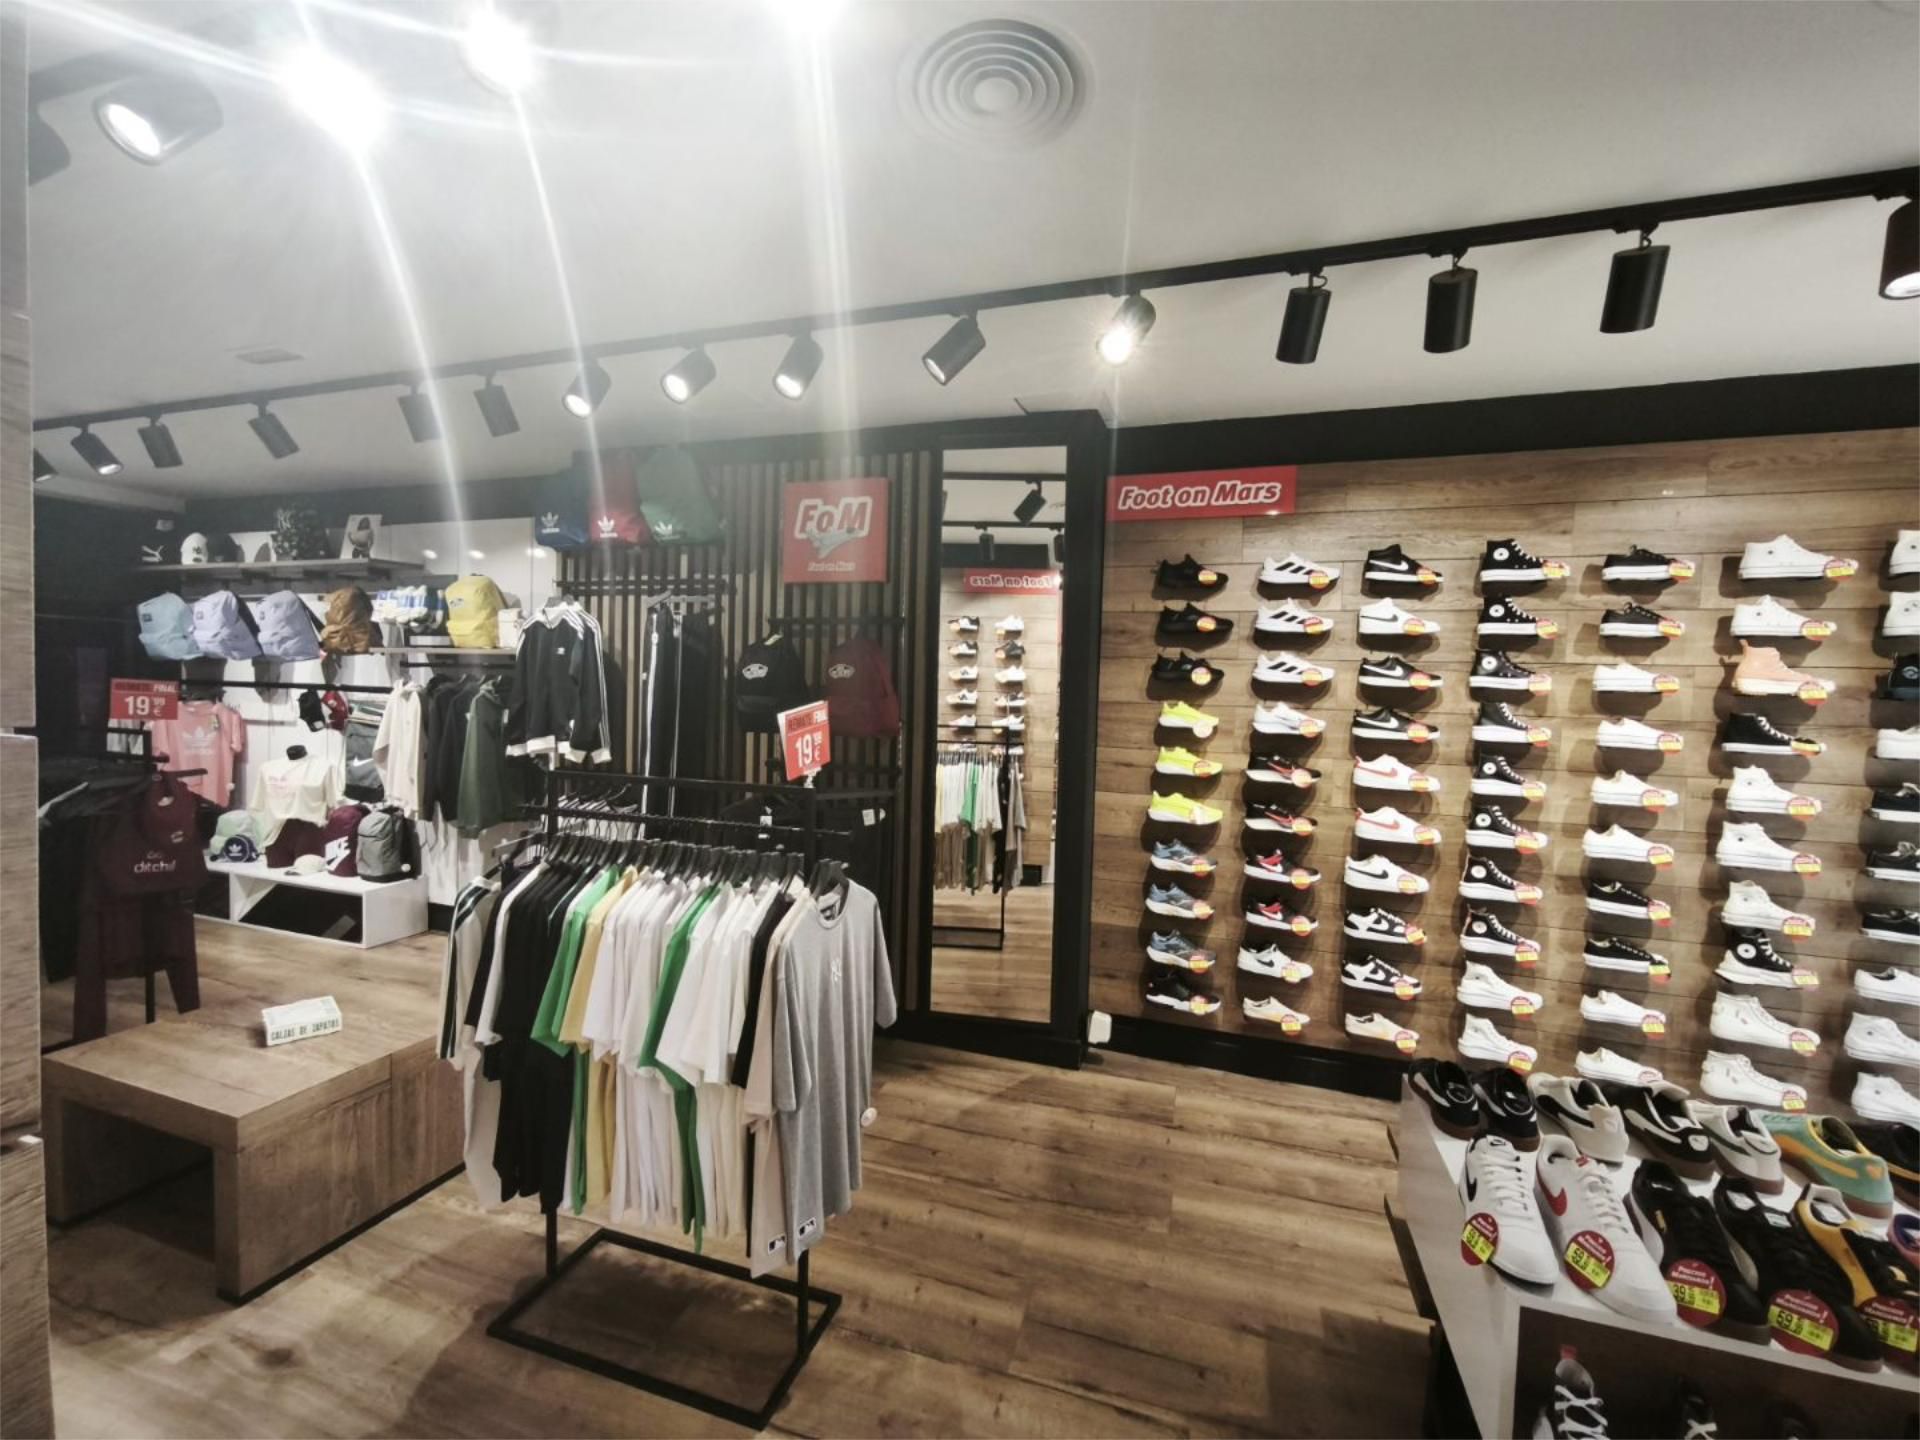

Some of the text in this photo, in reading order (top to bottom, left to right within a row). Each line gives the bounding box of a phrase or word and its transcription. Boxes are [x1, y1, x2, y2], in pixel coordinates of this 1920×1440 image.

[1118, 480, 1281, 510] Foot on Mars
[794, 496, 873, 539] FoM
[153, 683, 177, 692] FINAL
[125, 696, 149, 716] 19
[795, 733, 813, 768] 19
